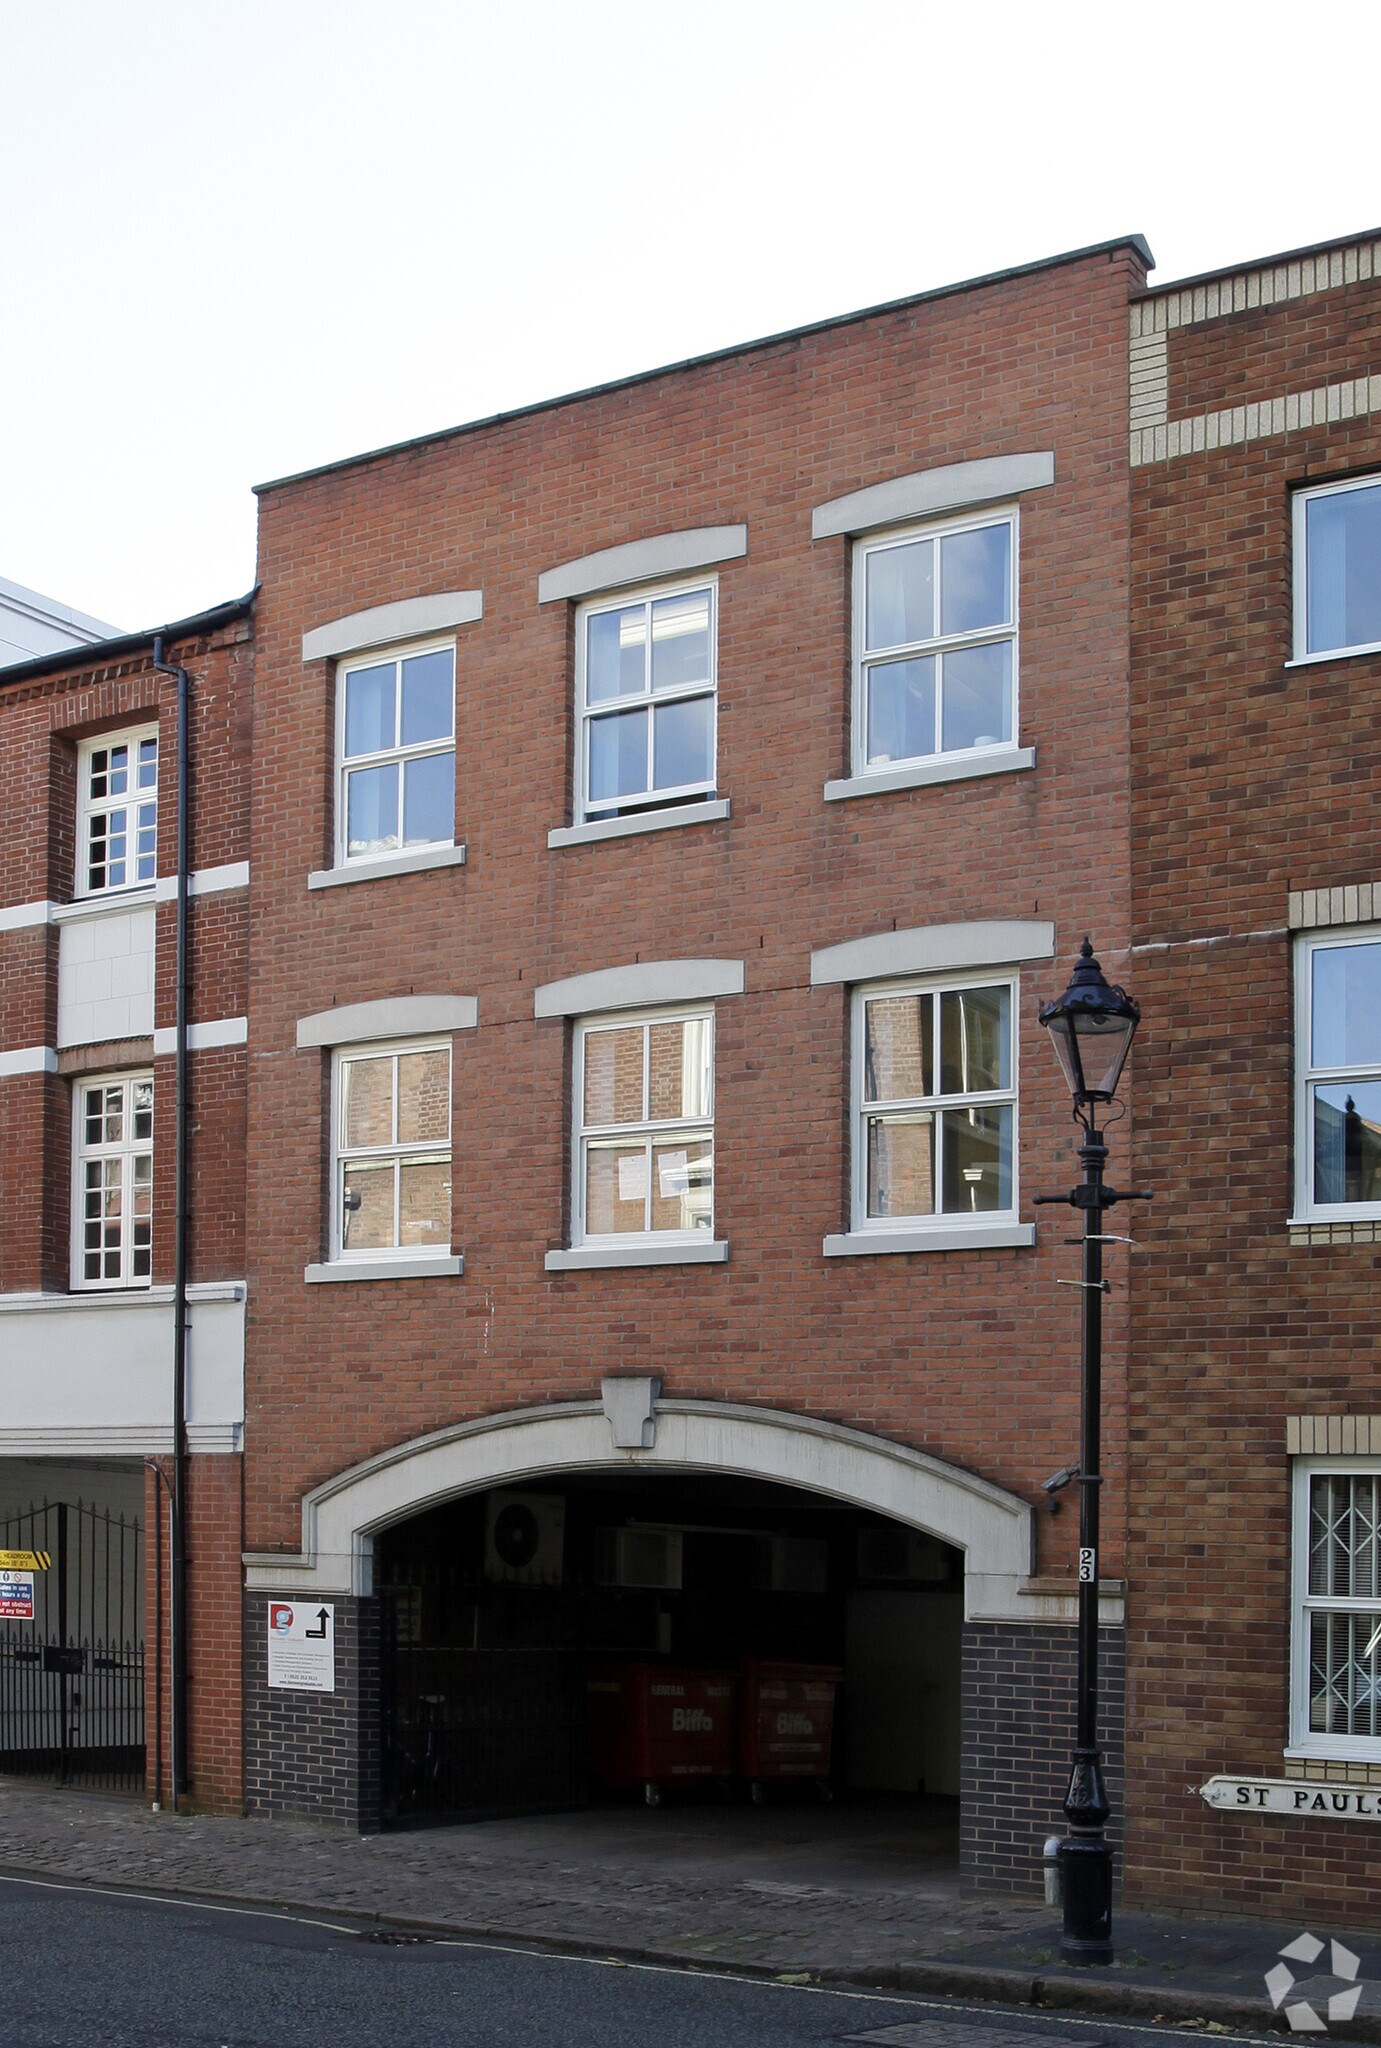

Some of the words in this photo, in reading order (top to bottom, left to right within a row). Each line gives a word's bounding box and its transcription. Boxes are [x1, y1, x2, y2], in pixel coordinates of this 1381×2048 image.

[651, 1685, 687, 1696] GENERAL
[672, 1708, 713, 1731] Biffa
[777, 1712, 813, 1734] Biffa
[1236, 1787, 1269, 1806] ST
